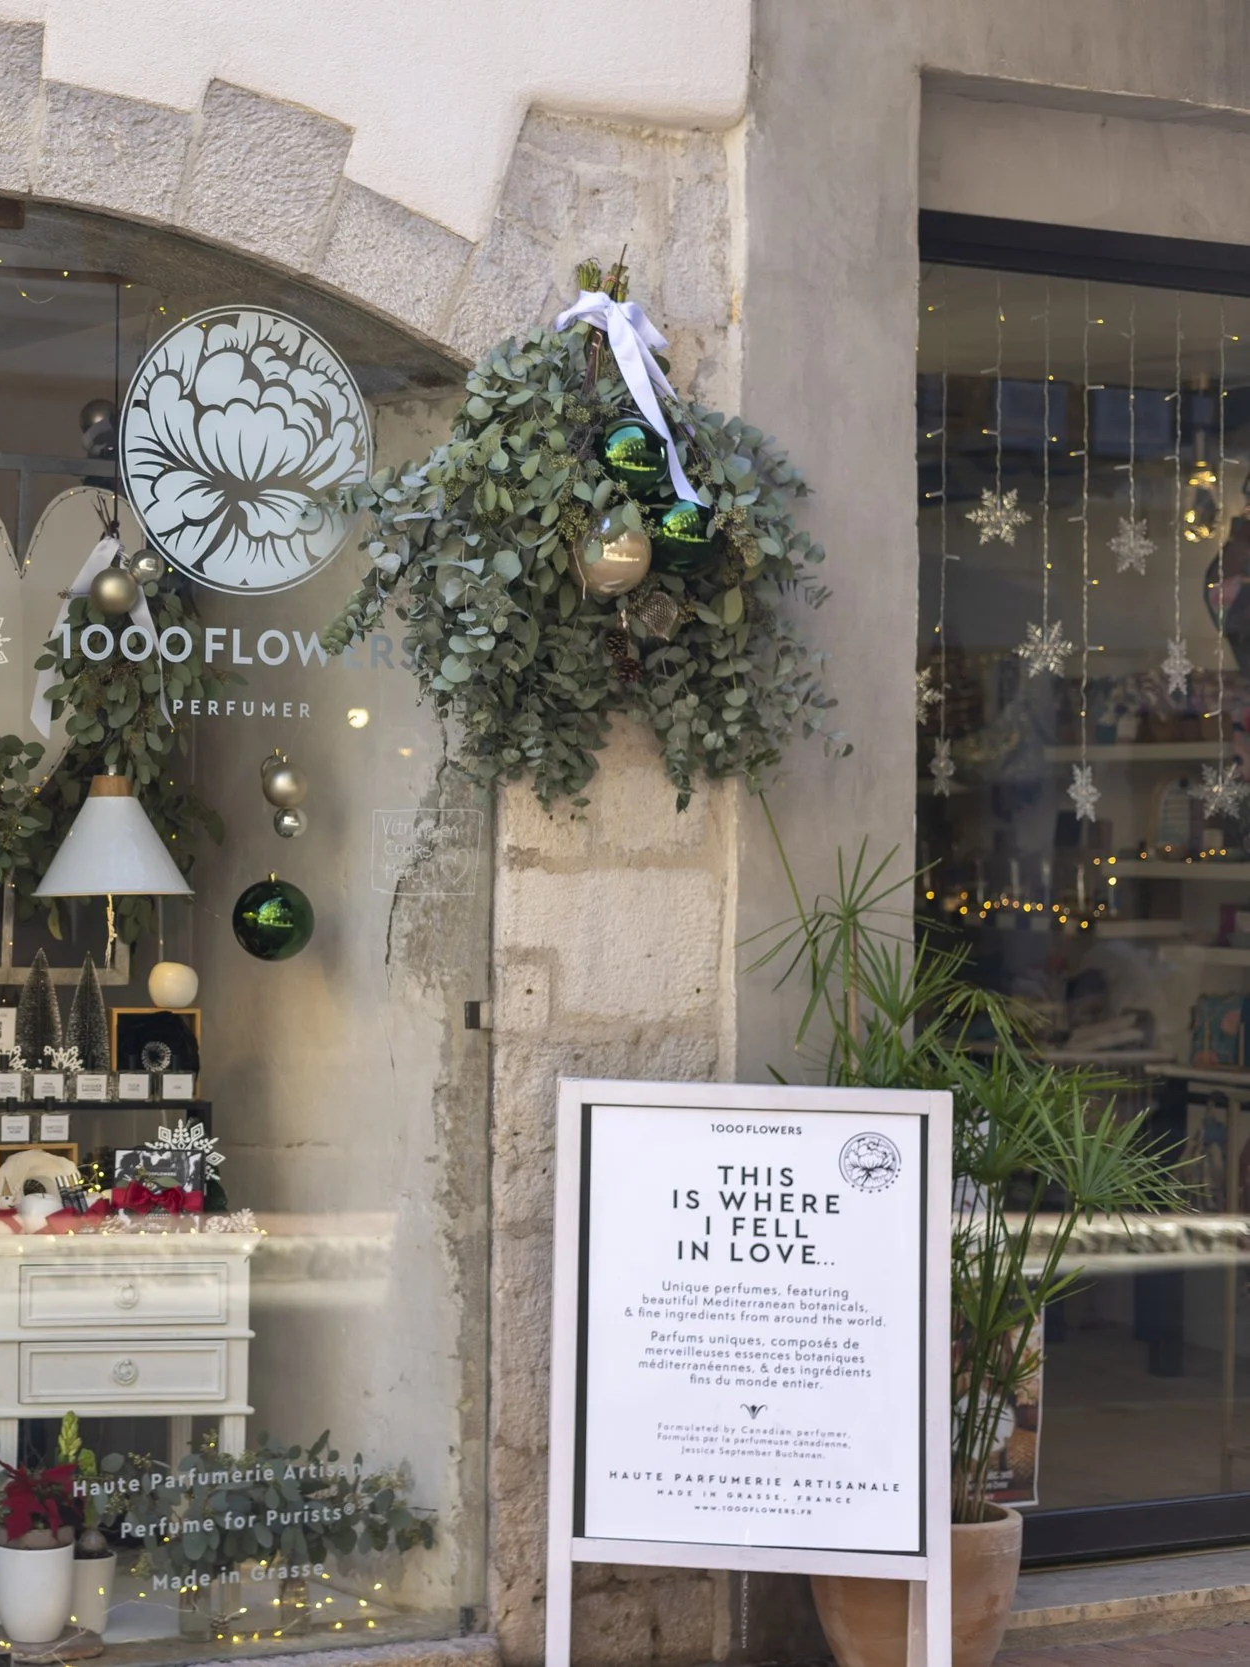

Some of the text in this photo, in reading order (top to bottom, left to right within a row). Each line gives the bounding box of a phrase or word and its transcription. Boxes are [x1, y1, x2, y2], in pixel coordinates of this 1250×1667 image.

[60, 624, 193, 663] 1000
[172, 699, 311, 719] PERFUMER
[717, 1165, 794, 1187] THIS
[673, 1189, 840, 1214] IS WHERE
[706, 1216, 809, 1239] I FELL
[678, 1240, 835, 1266] IN LOVE...
[661, 1280, 849, 1301] Unique perfumes, featuring
[641, 1293, 868, 1313] beautiful Mediterranean botanicals,
[624, 1306, 887, 1327] & fine ingredients from around the world.
[651, 1330, 860, 1350] Parfums uniques, composés de
[645, 1346, 866, 1365] merveilleuses essences botaniques
[638, 1359, 872, 1379] méditerranéennes, & des ingrédients
[689, 1372, 824, 1390] fins du monde entier.
[657, 1422, 719, 1433] Formulated
[723, 1425, 736, 1435] by
[740, 1425, 792, 1436] Canadian
[681, 1445, 715, 1455] Jessica
[718, 1446, 771, 1457] September
[703, 1436, 719, 1444] par
[721, 1435, 731, 1443] la
[733, 1436, 789, 1446] parfumeuse
[72, 1477, 141, 1498] Haute
[150, 1463, 275, 1490] Parfumerie
[609, 1471, 901, 1492] HAUTE PARFUMERIE ARTISANALE
[657, 1489, 693, 1497] MADE
[797, 1495, 851, 1504] FRANCE
[120, 1512, 215, 1539] Perfume
[224, 1511, 257, 1530] for
[152, 1562, 325, 1592] Made in Grasse
